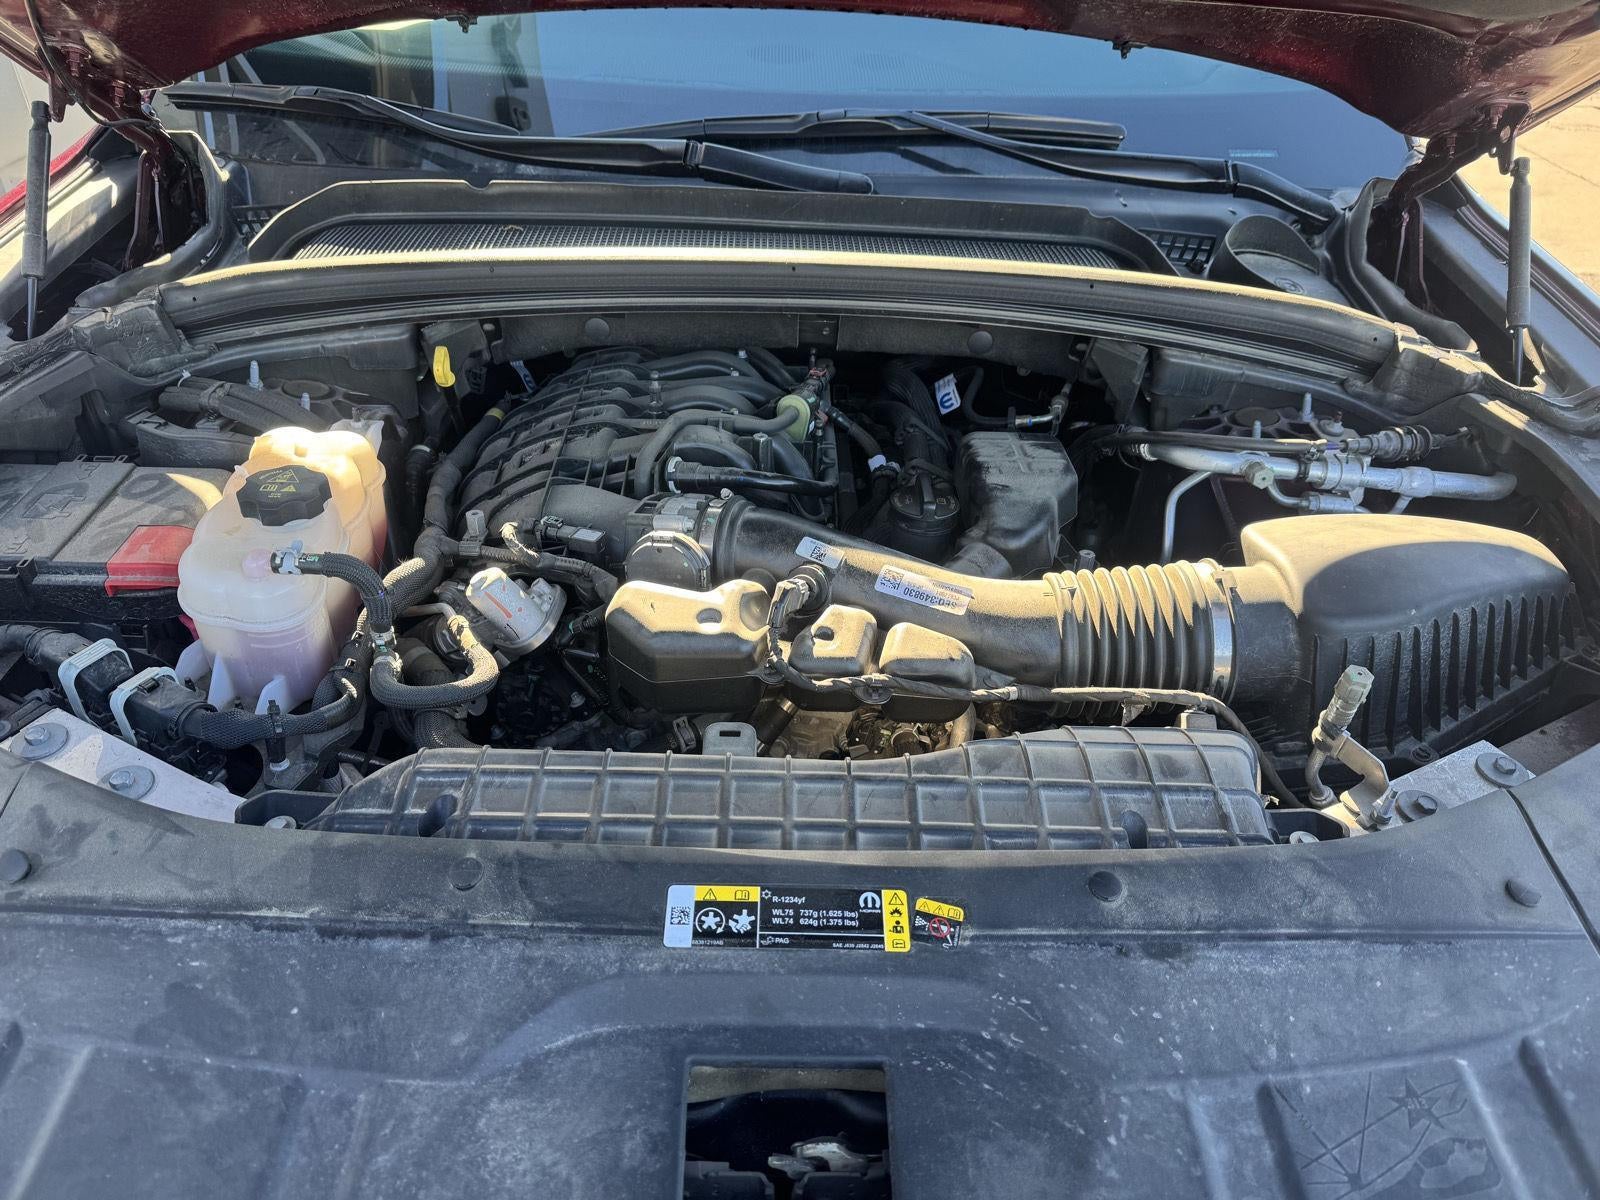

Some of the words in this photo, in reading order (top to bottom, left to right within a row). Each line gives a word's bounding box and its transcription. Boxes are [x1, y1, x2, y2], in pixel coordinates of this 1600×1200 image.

[772, 896, 806, 905] R-1234yf
[799, 909, 818, 918] 737g
[820, 910, 842, 918] (1.625
[843, 910, 859, 919] lbs)
[772, 917, 794, 925] WL74
[799, 917, 818, 926] 624g
[820, 918, 842, 927] (1.375
[844, 918, 859, 927] lbs)
[774, 937, 790, 945] PAG
